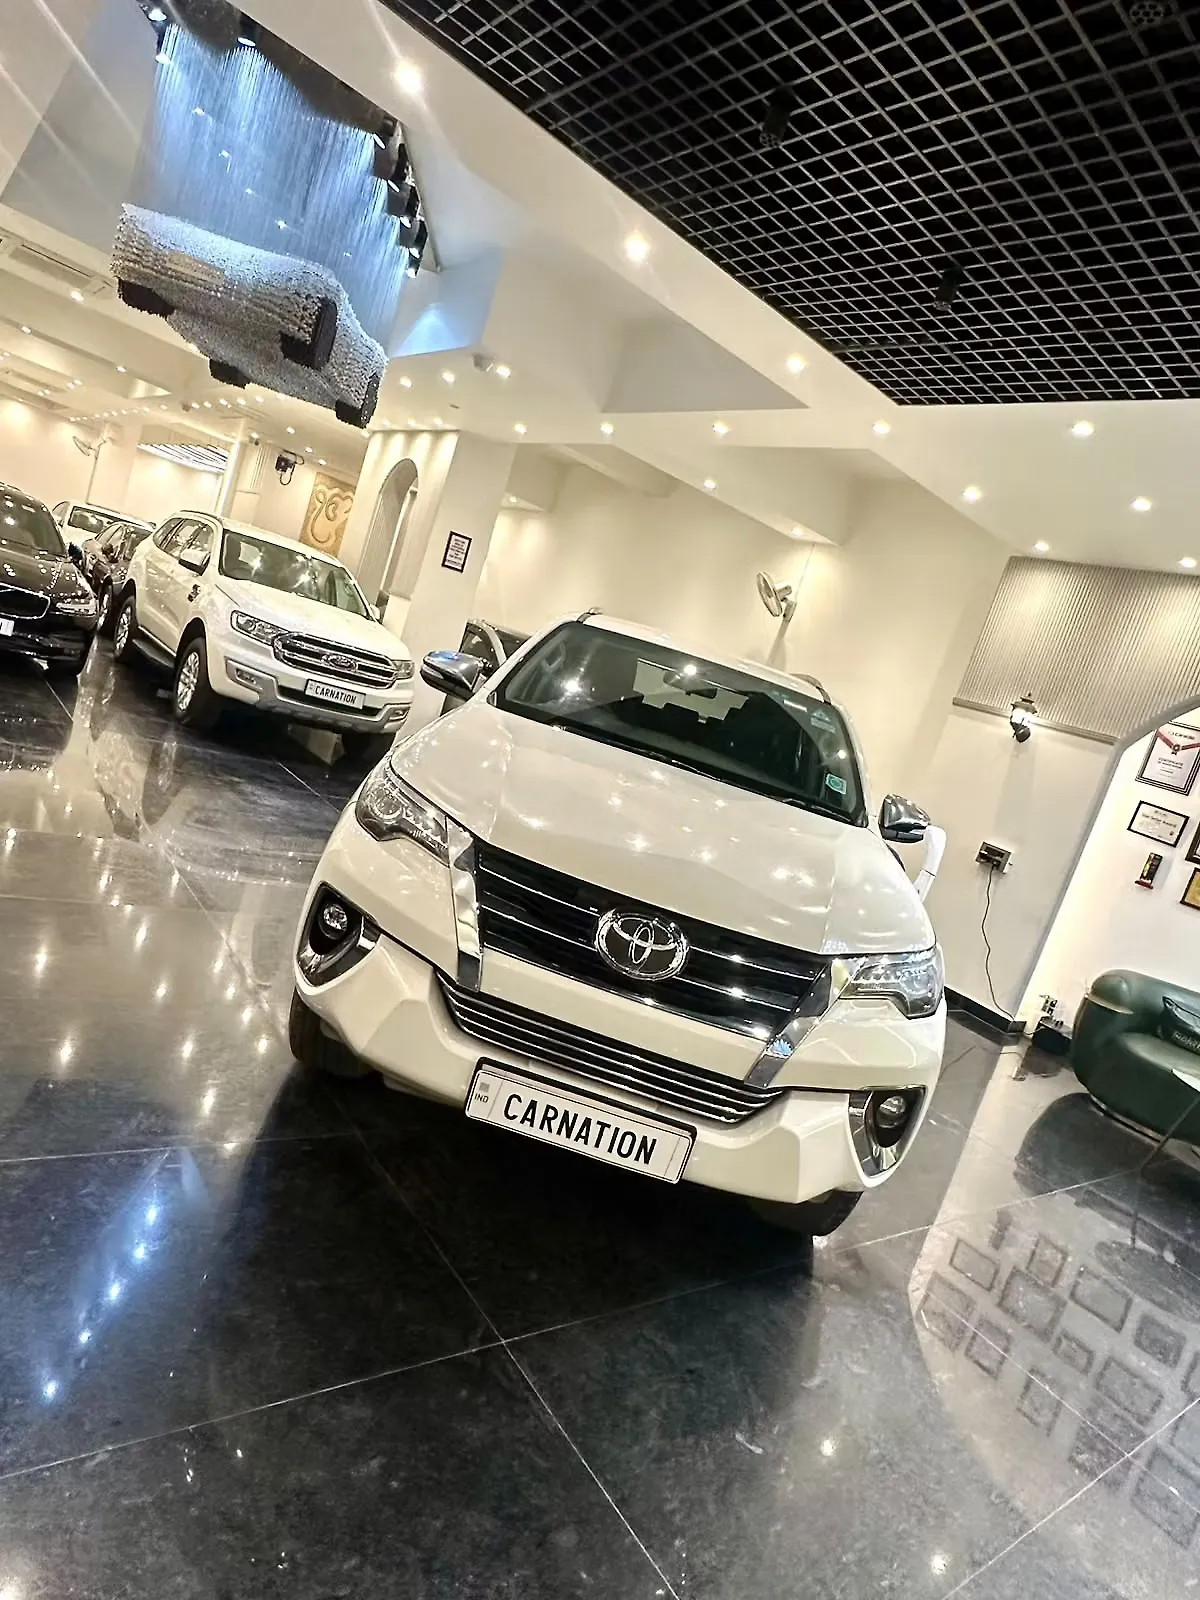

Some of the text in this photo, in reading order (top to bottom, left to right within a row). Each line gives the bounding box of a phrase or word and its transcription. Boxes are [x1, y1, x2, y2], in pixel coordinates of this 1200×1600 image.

[315, 685, 357, 704] CARNATION
[474, 1093, 489, 1103] IND
[503, 1093, 657, 1165] CARNATION
